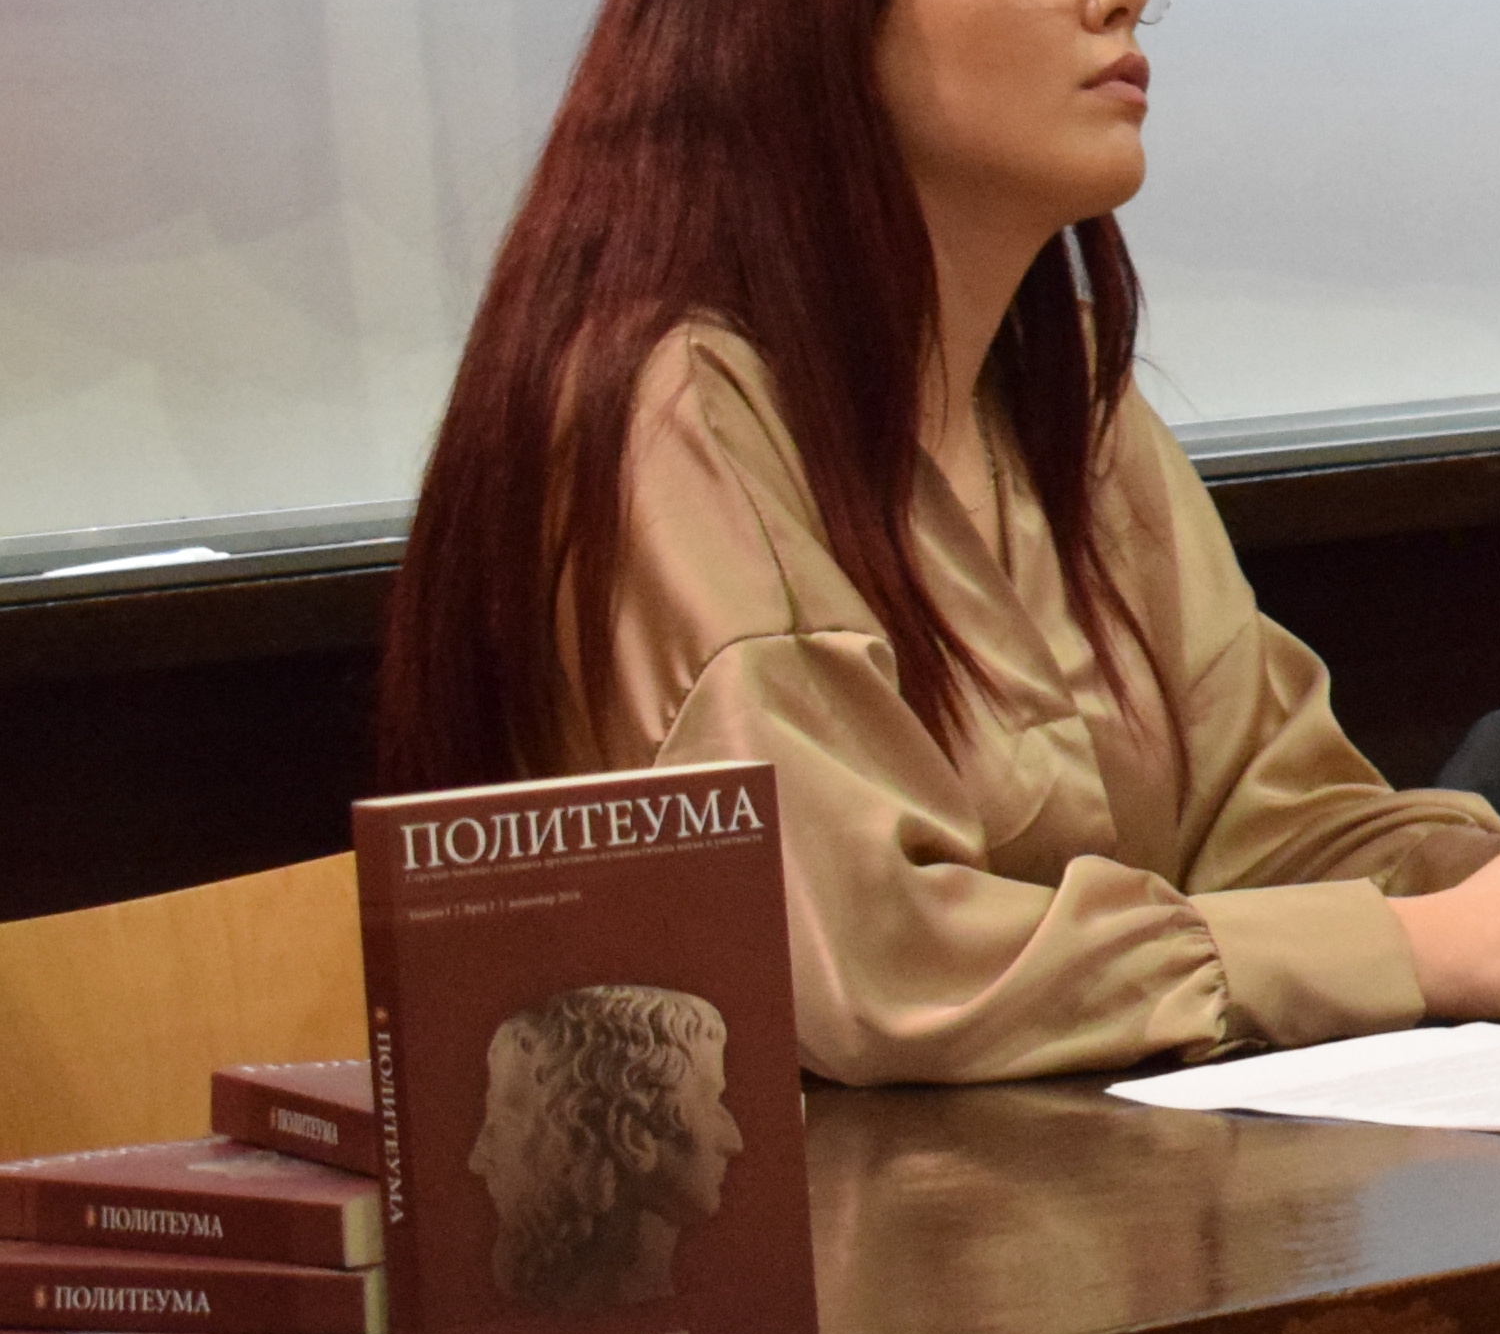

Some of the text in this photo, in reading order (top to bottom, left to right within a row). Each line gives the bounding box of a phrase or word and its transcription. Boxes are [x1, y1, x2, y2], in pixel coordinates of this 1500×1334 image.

[400, 785, 765, 870] ПОЛИТЕУМА
[277, 1108, 339, 1146] ПОЛИТЕУМА
[377, 1032, 404, 1225] ПОЛИТЕУМА
[101, 1205, 224, 1239] ПОЛИТЕУМА
[53, 1284, 211, 1314] ПОЛИТЕУМА
